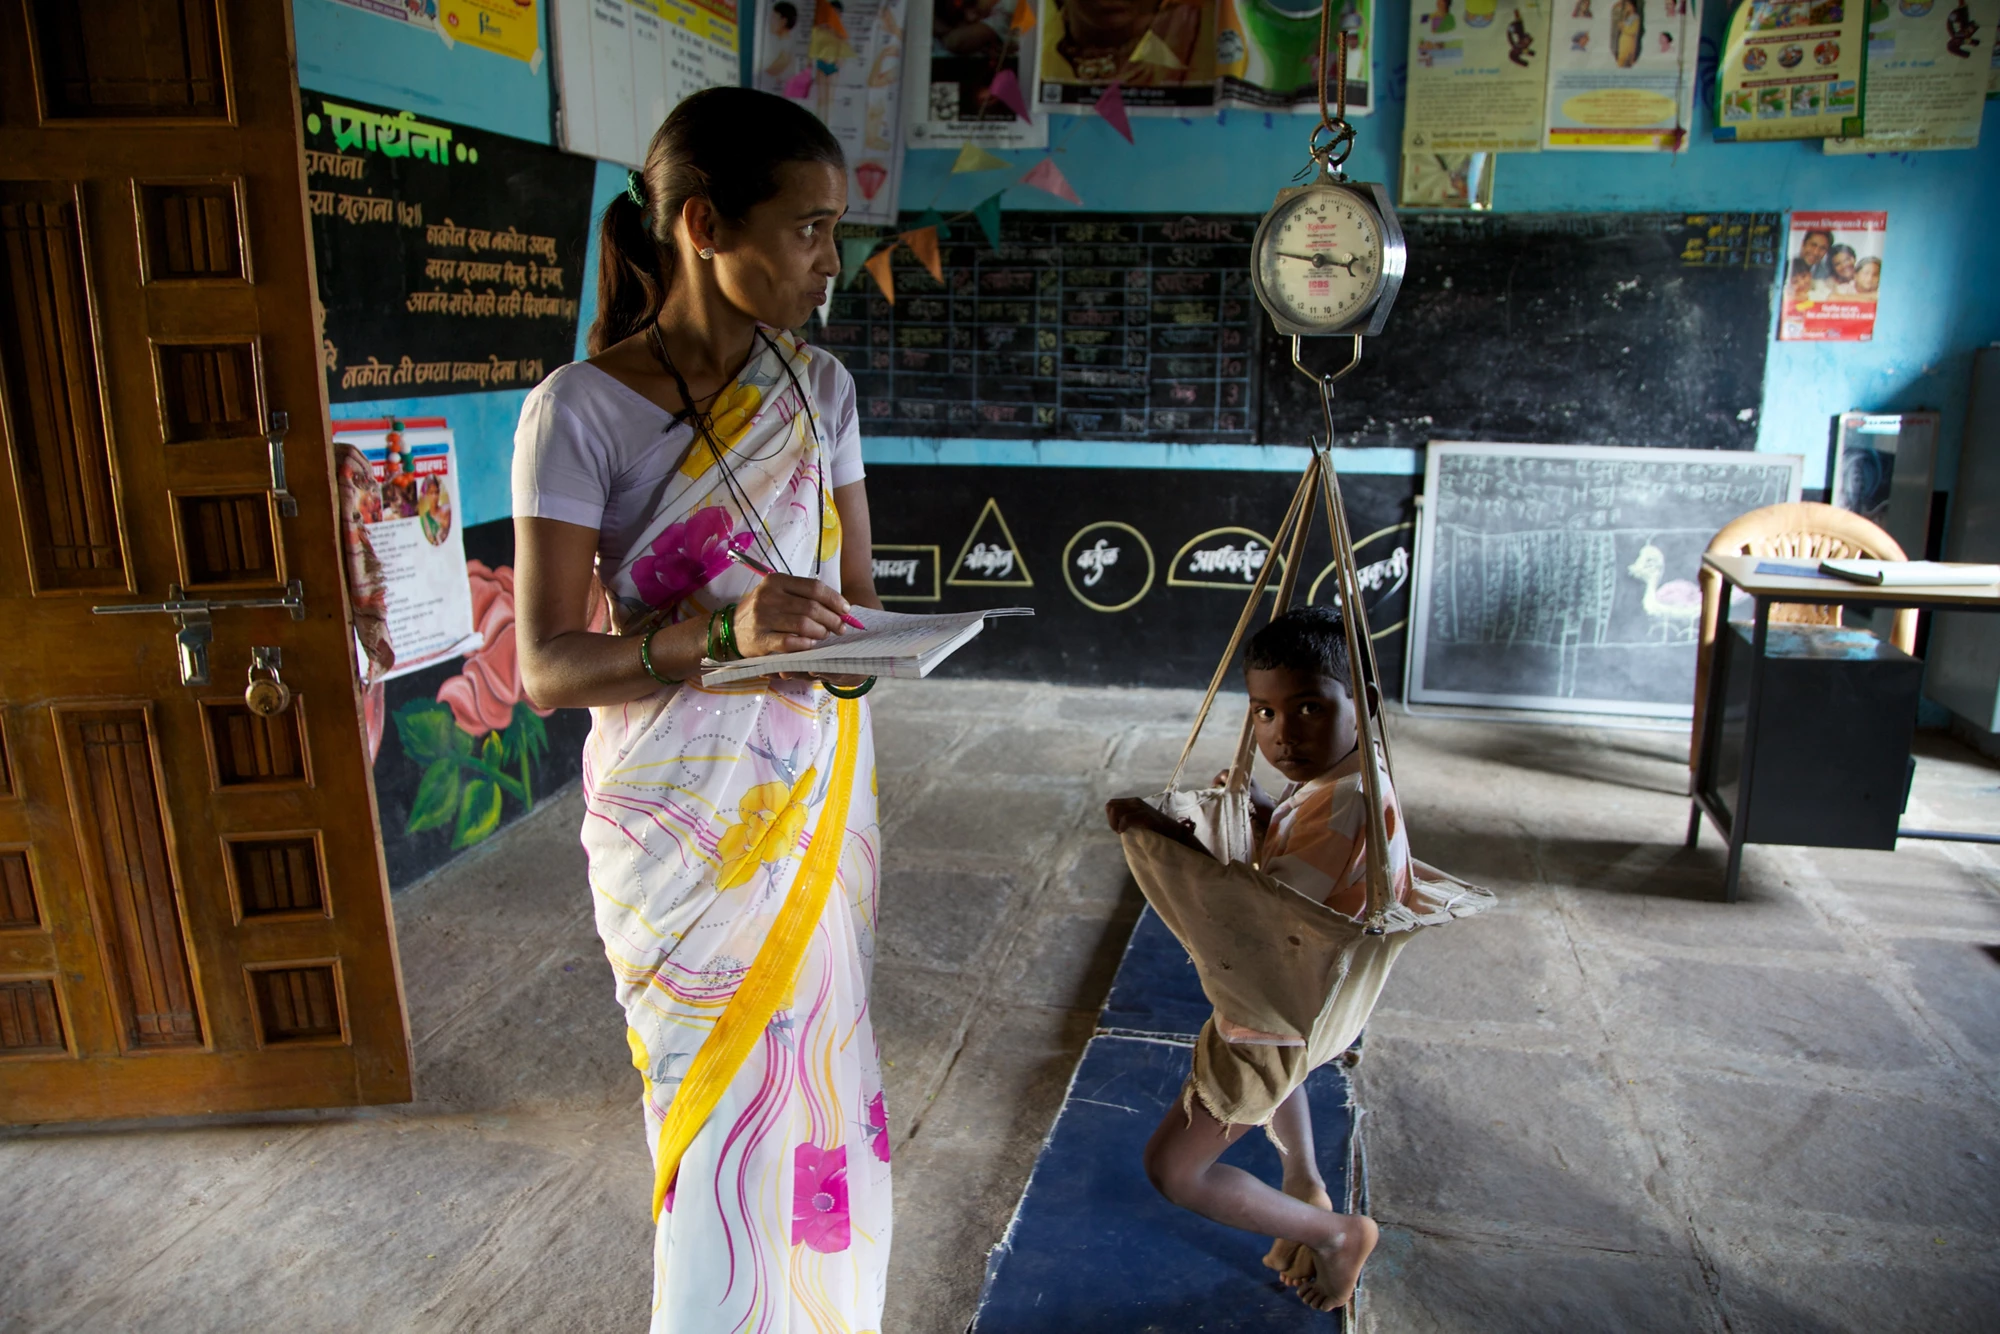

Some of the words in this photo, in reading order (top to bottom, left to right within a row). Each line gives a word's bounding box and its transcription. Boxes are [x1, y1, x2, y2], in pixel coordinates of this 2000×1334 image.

[322, 101, 452, 165] प्रार्थना
[1160, 216, 1246, 243] शनिवार
[1365, 235, 1369, 243] 4
[1368, 250, 1373, 258] 5
[1366, 265, 1370, 273] 6
[1308, 280, 1329, 288] ICDS
[405, 286, 448, 315] आनंद
[1324, 306, 1331, 314] 10
[341, 356, 393, 390] नकोत
[393, 354, 415, 385] ती
